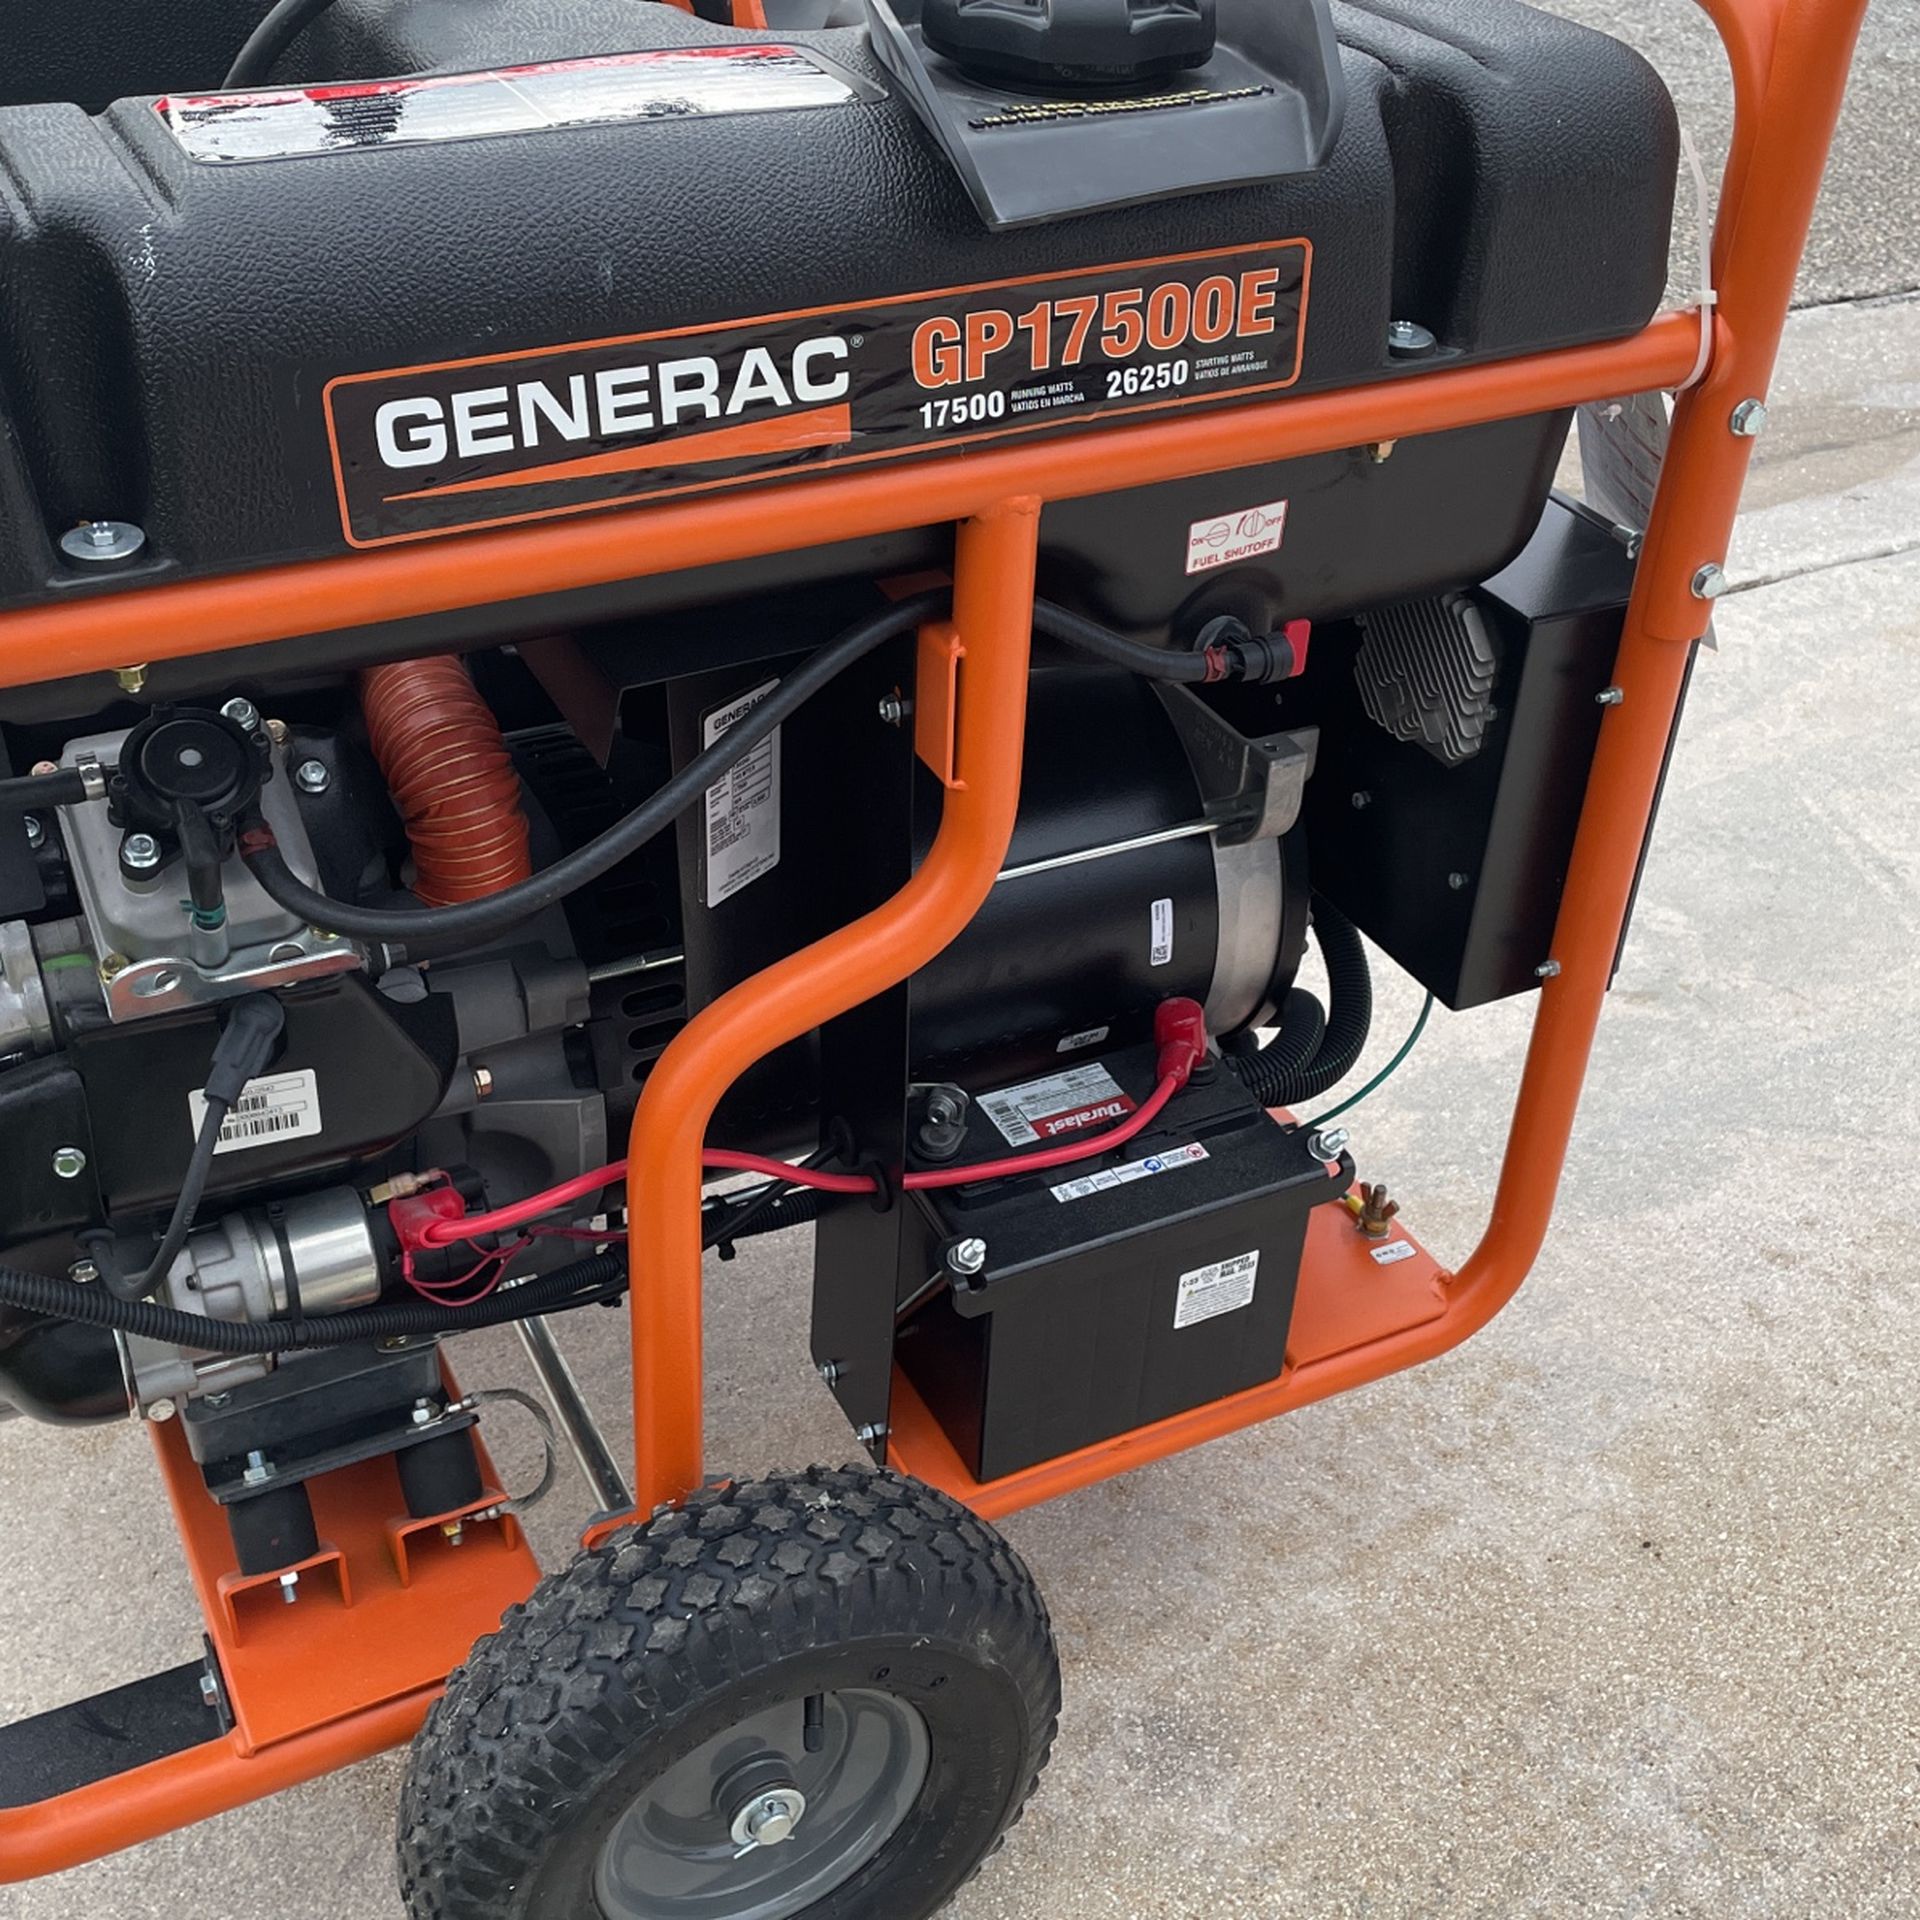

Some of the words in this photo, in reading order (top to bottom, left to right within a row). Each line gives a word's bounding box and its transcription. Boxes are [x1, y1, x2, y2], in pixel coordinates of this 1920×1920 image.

[911, 267, 1280, 388] GP17500E
[1195, 354, 1230, 369] STARTING
[1231, 350, 1255, 362] WATTS
[1220, 366, 1230, 376] DE
[1011, 385, 1046, 400] RUNNING
[1047, 381, 1074, 394] WATTS
[1106, 359, 1188, 398] 26250
[375, 336, 850, 469] GENERAC
[919, 391, 1005, 429] 17500
[1011, 399, 1039, 412] VATIOS
[1040, 397, 1051, 408] EN
[1052, 392, 1085, 406] MARCHA
[1264, 516, 1283, 527] OFF
[1191, 537, 1204, 546] ON
[1193, 554, 1221, 569] FUEL
[1224, 537, 1275, 560] SHUTOFF
[1045, 1102, 1128, 1135] Duralast
